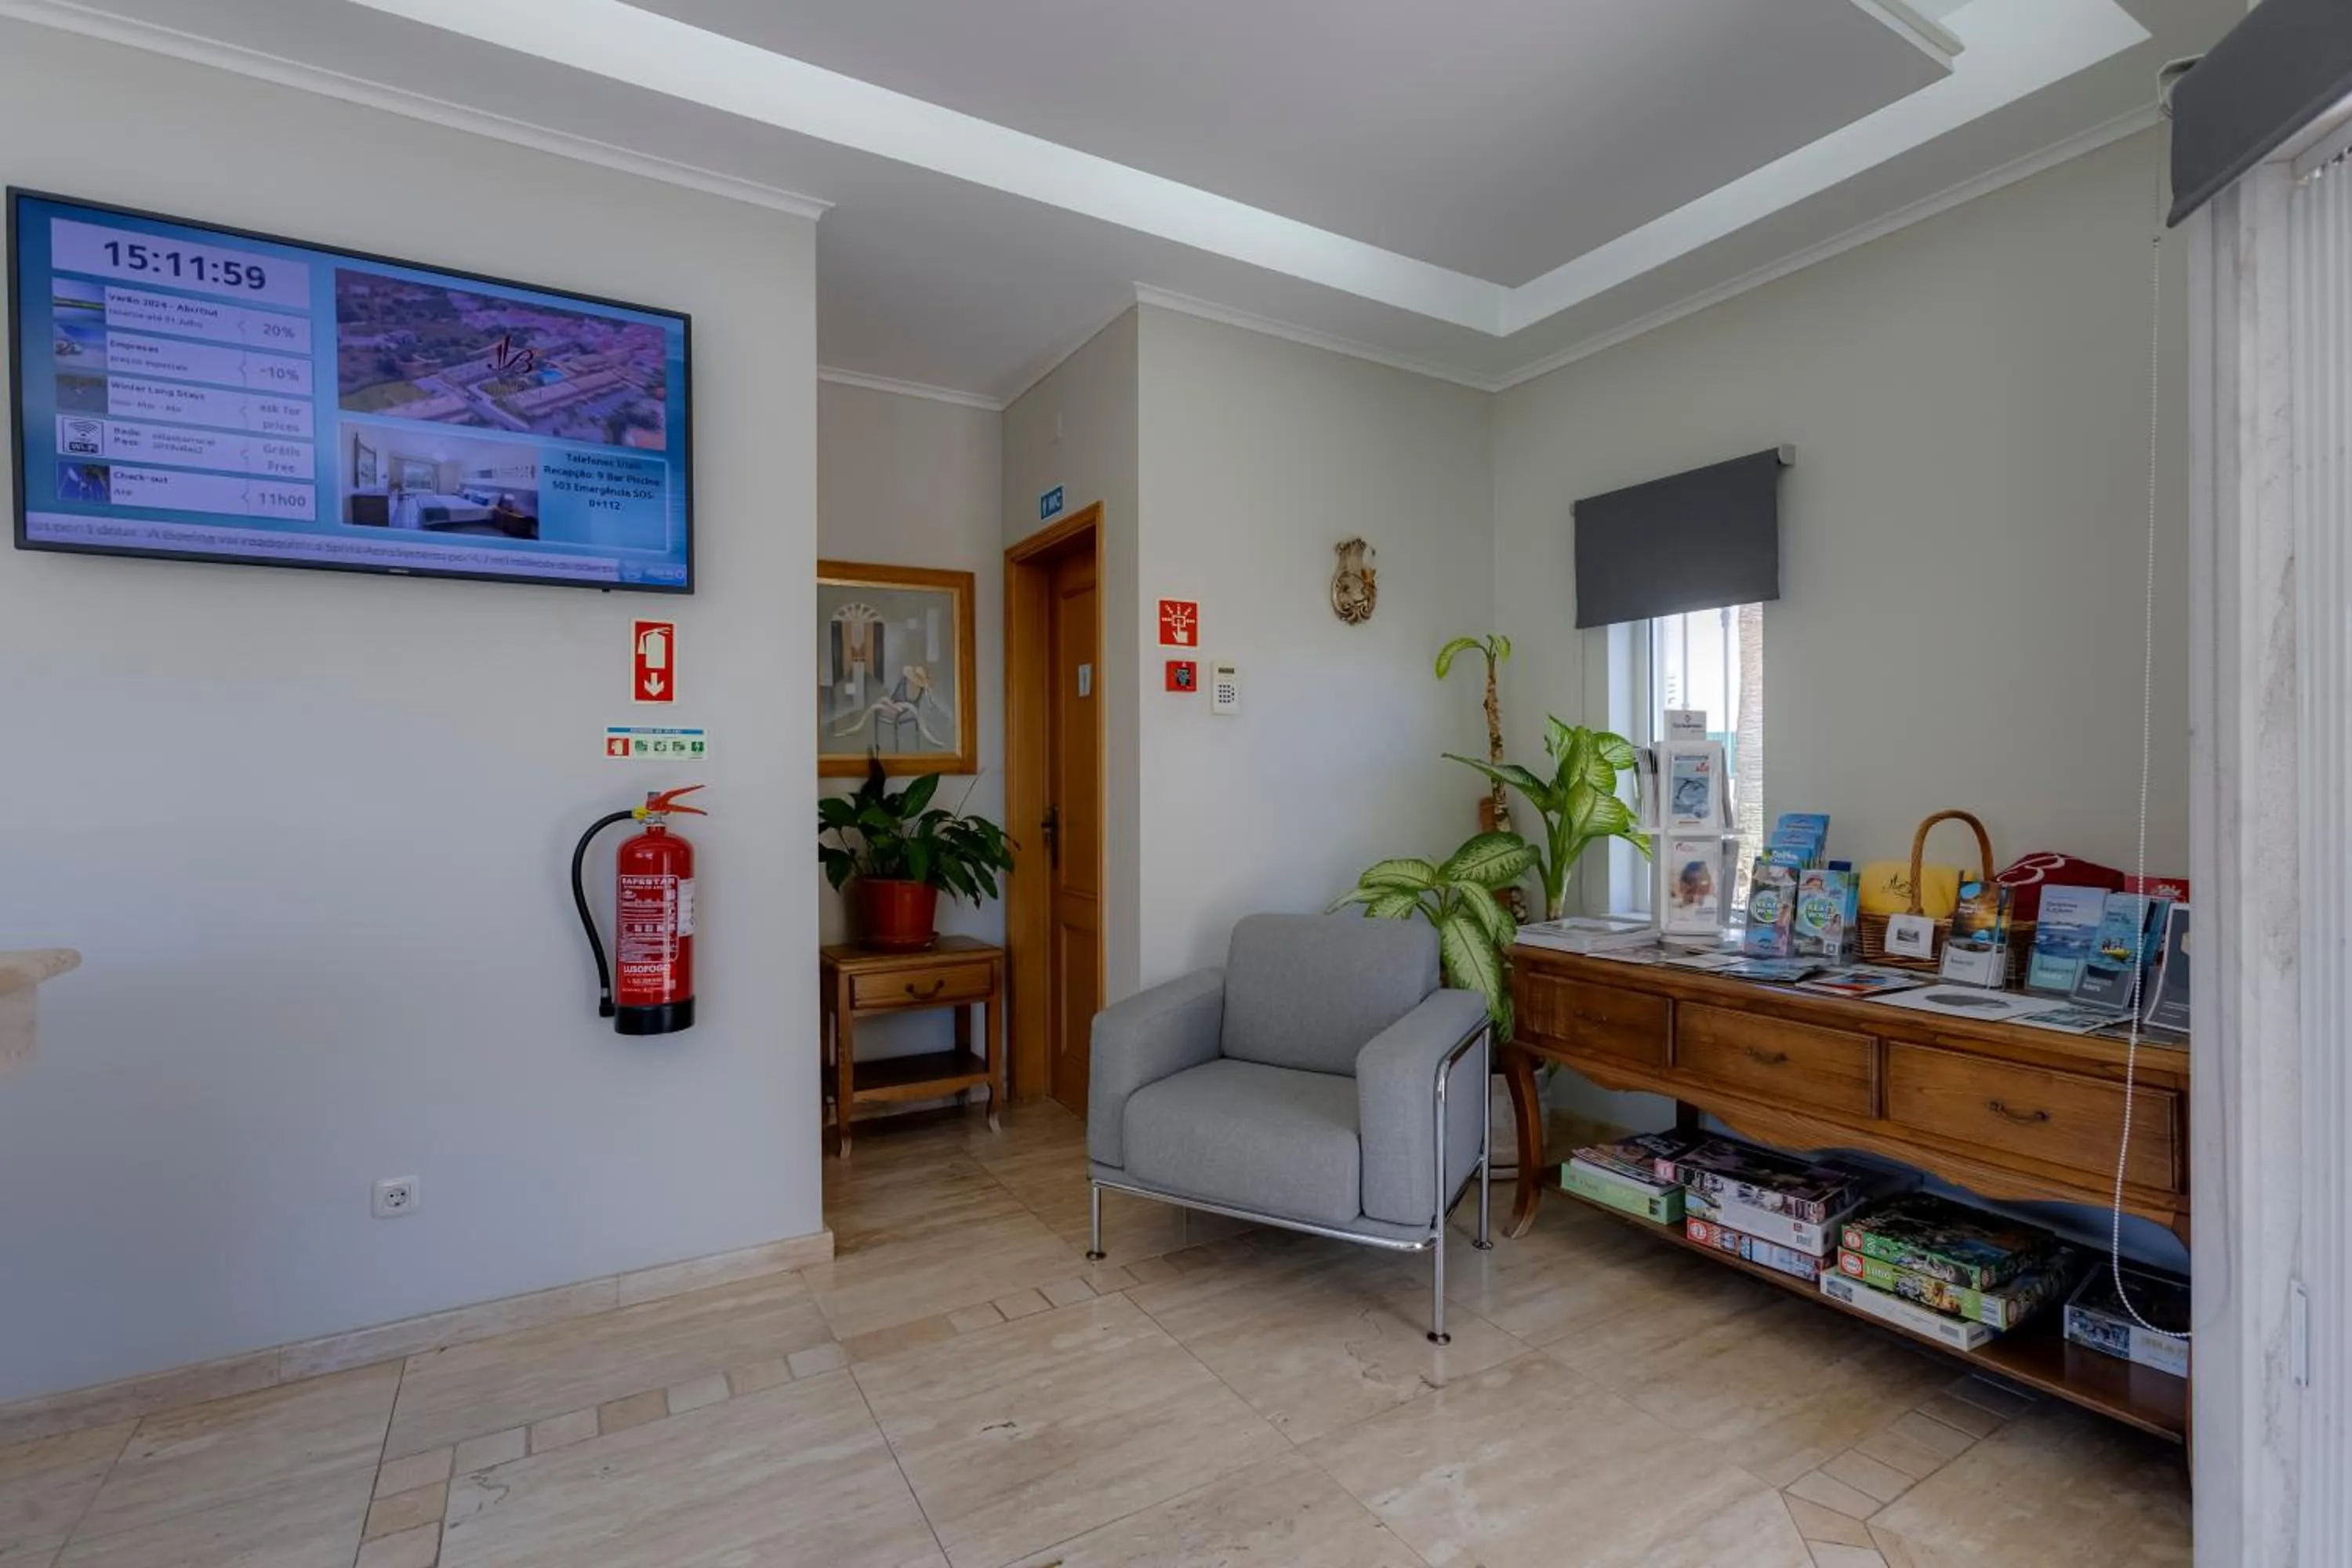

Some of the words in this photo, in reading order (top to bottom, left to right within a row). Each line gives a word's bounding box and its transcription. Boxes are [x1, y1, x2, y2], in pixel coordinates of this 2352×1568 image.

[104, 241, 267, 290] 15:11:59
[263, 323, 296, 339] 20%
[260, 365, 299, 382] -10%
[258, 492, 307, 507] 11h00
